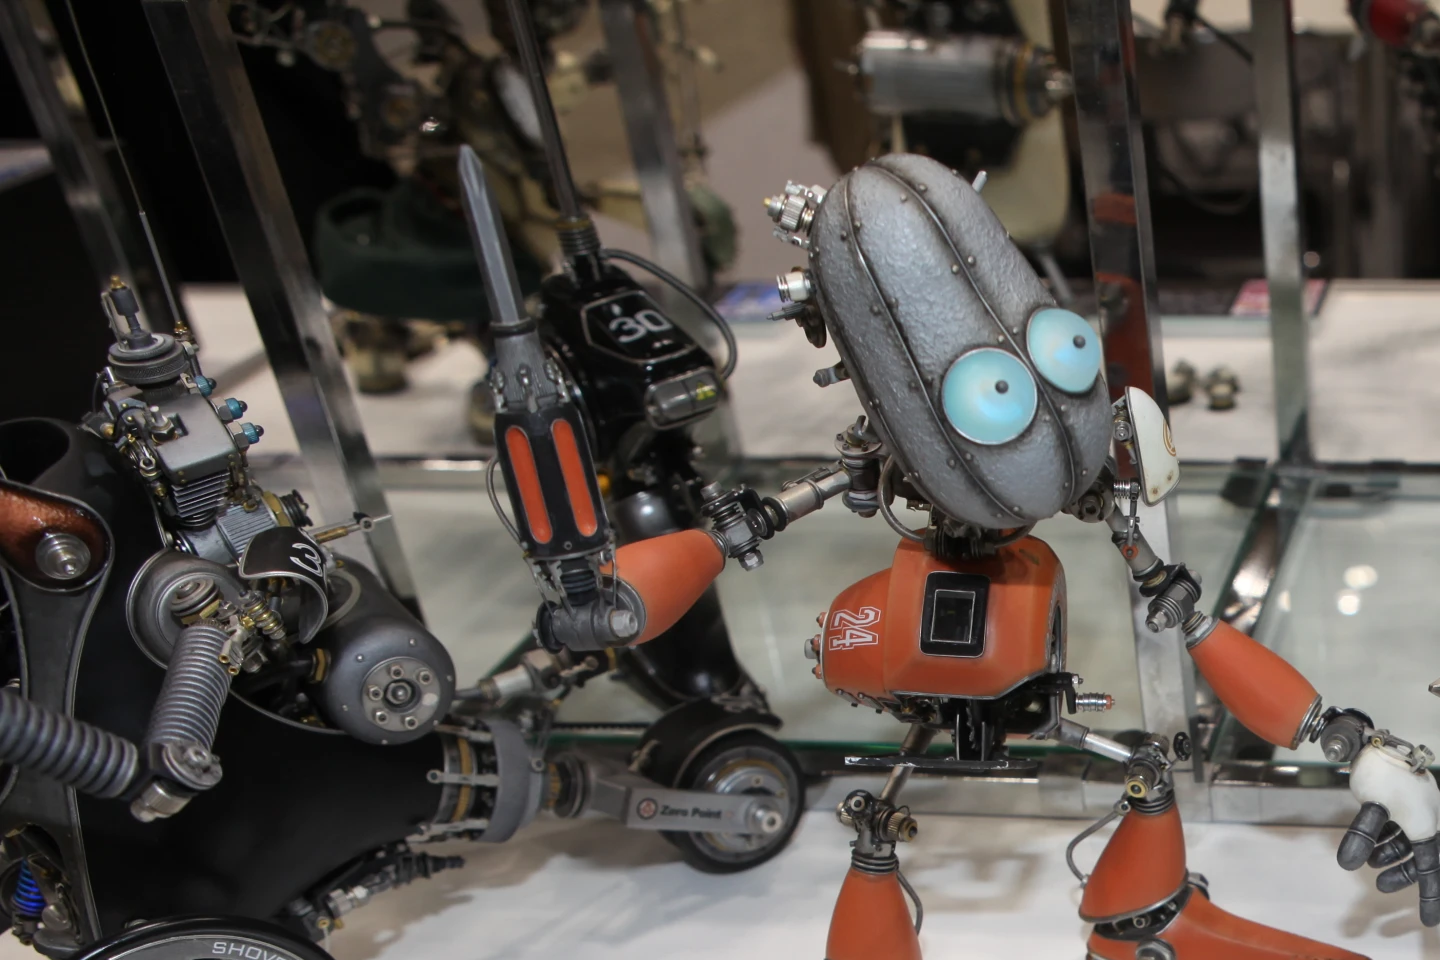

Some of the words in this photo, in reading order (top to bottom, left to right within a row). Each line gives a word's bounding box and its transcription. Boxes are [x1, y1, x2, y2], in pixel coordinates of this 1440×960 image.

[609, 309, 672, 342] 30
[829, 606, 881, 650] 24
[691, 806, 722, 820] Point
